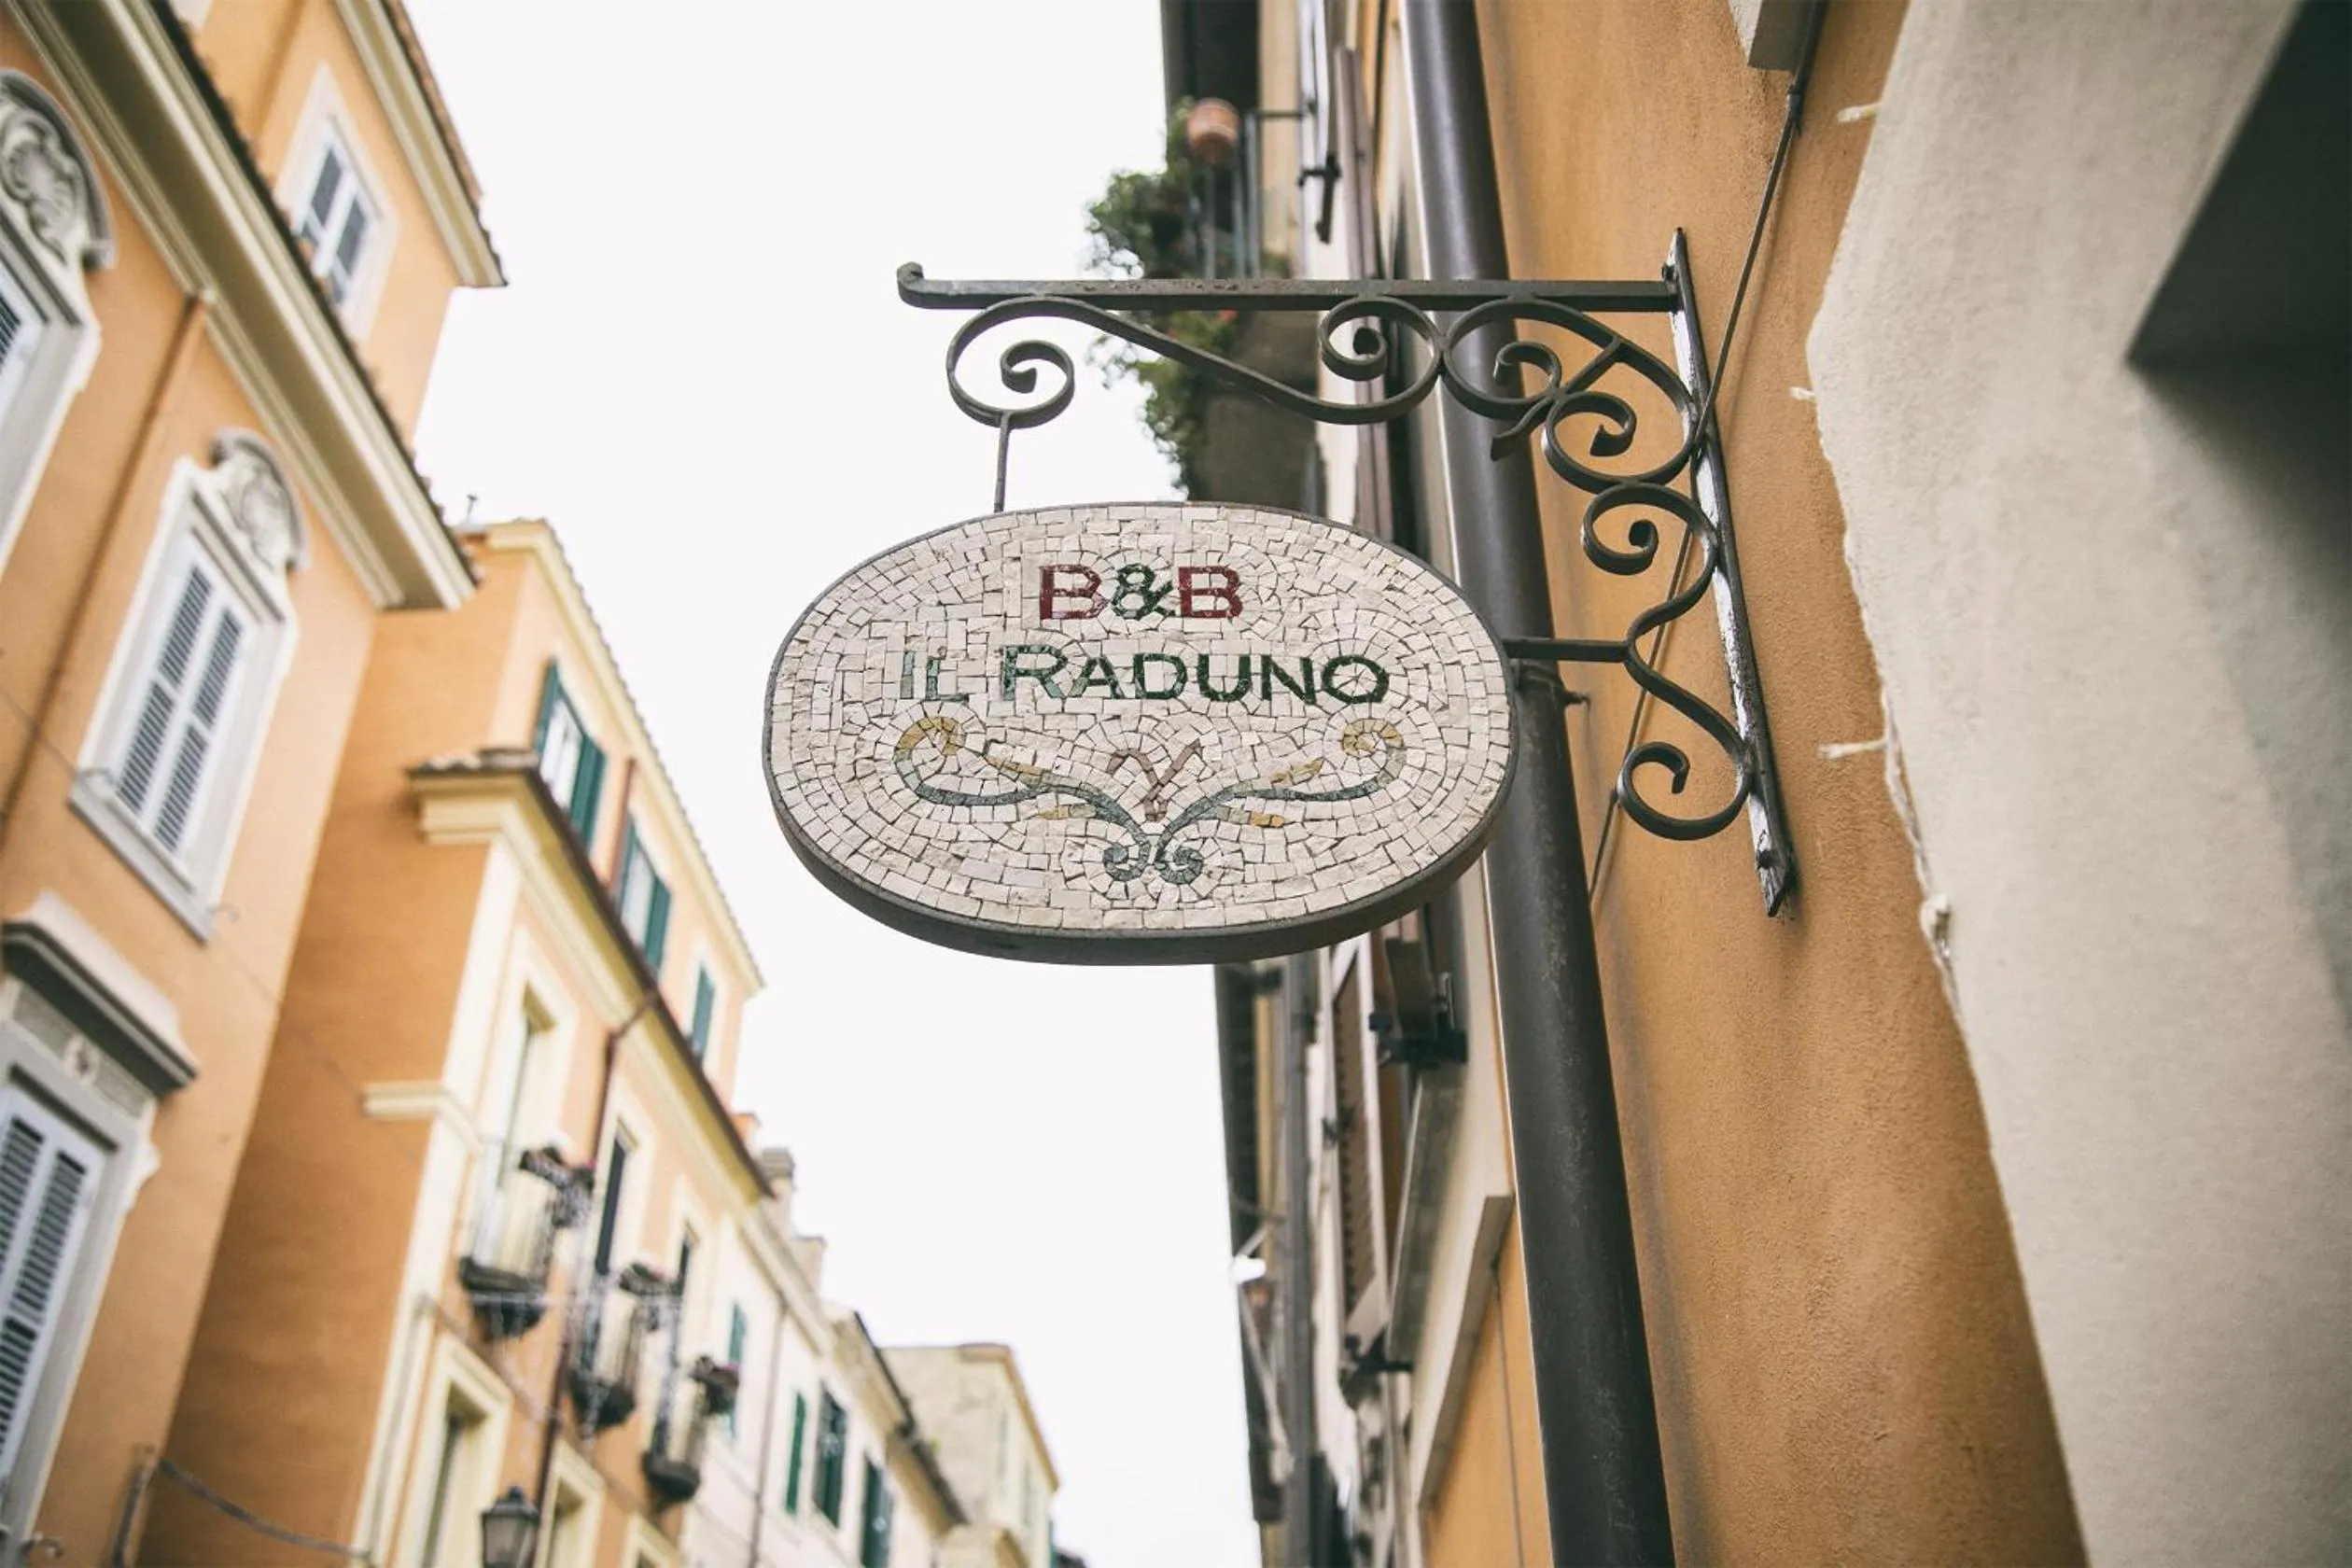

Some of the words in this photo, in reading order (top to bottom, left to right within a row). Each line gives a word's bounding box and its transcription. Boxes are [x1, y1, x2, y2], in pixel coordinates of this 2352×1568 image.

[1040, 564, 1243, 620] B&B
[902, 651, 969, 700] IL
[1002, 646, 1389, 705] RADUNO
